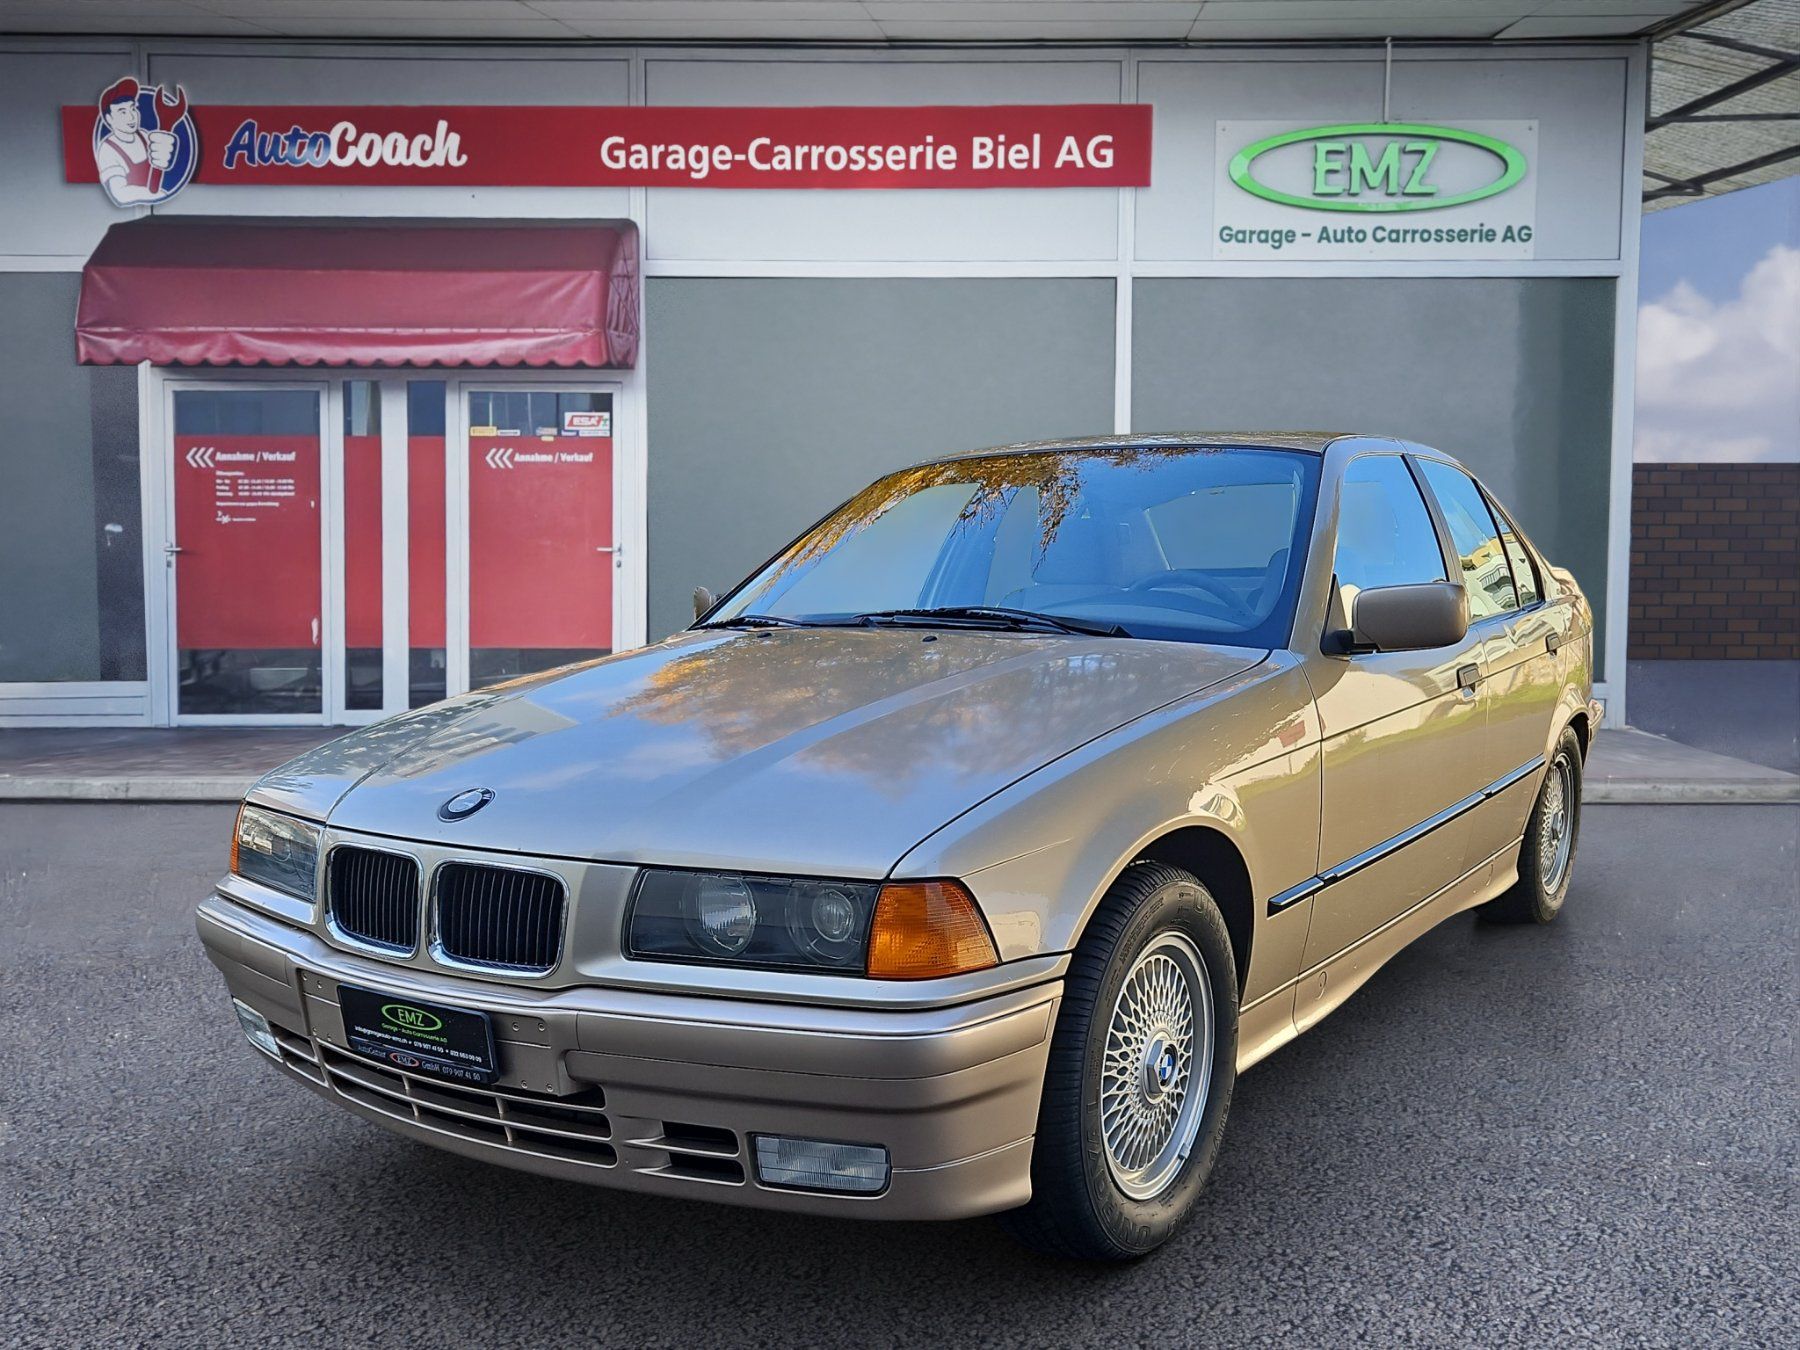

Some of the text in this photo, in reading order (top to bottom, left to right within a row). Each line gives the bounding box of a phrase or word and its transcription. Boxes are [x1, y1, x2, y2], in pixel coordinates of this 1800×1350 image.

[223, 119, 468, 169] AutoCoach
[600, 133, 1115, 179] Garage-Carrosserie Biel AG
[1312, 140, 1440, 197] EMZ
[1218, 225, 1297, 250] Garage
[1317, 225, 1368, 244] Auto
[1371, 222, 1497, 244] Carrosserie
[1501, 224, 1534, 244] AG
[560, 452, 593, 462] Verkauf
[397, 1008, 425, 1027] EMZ
